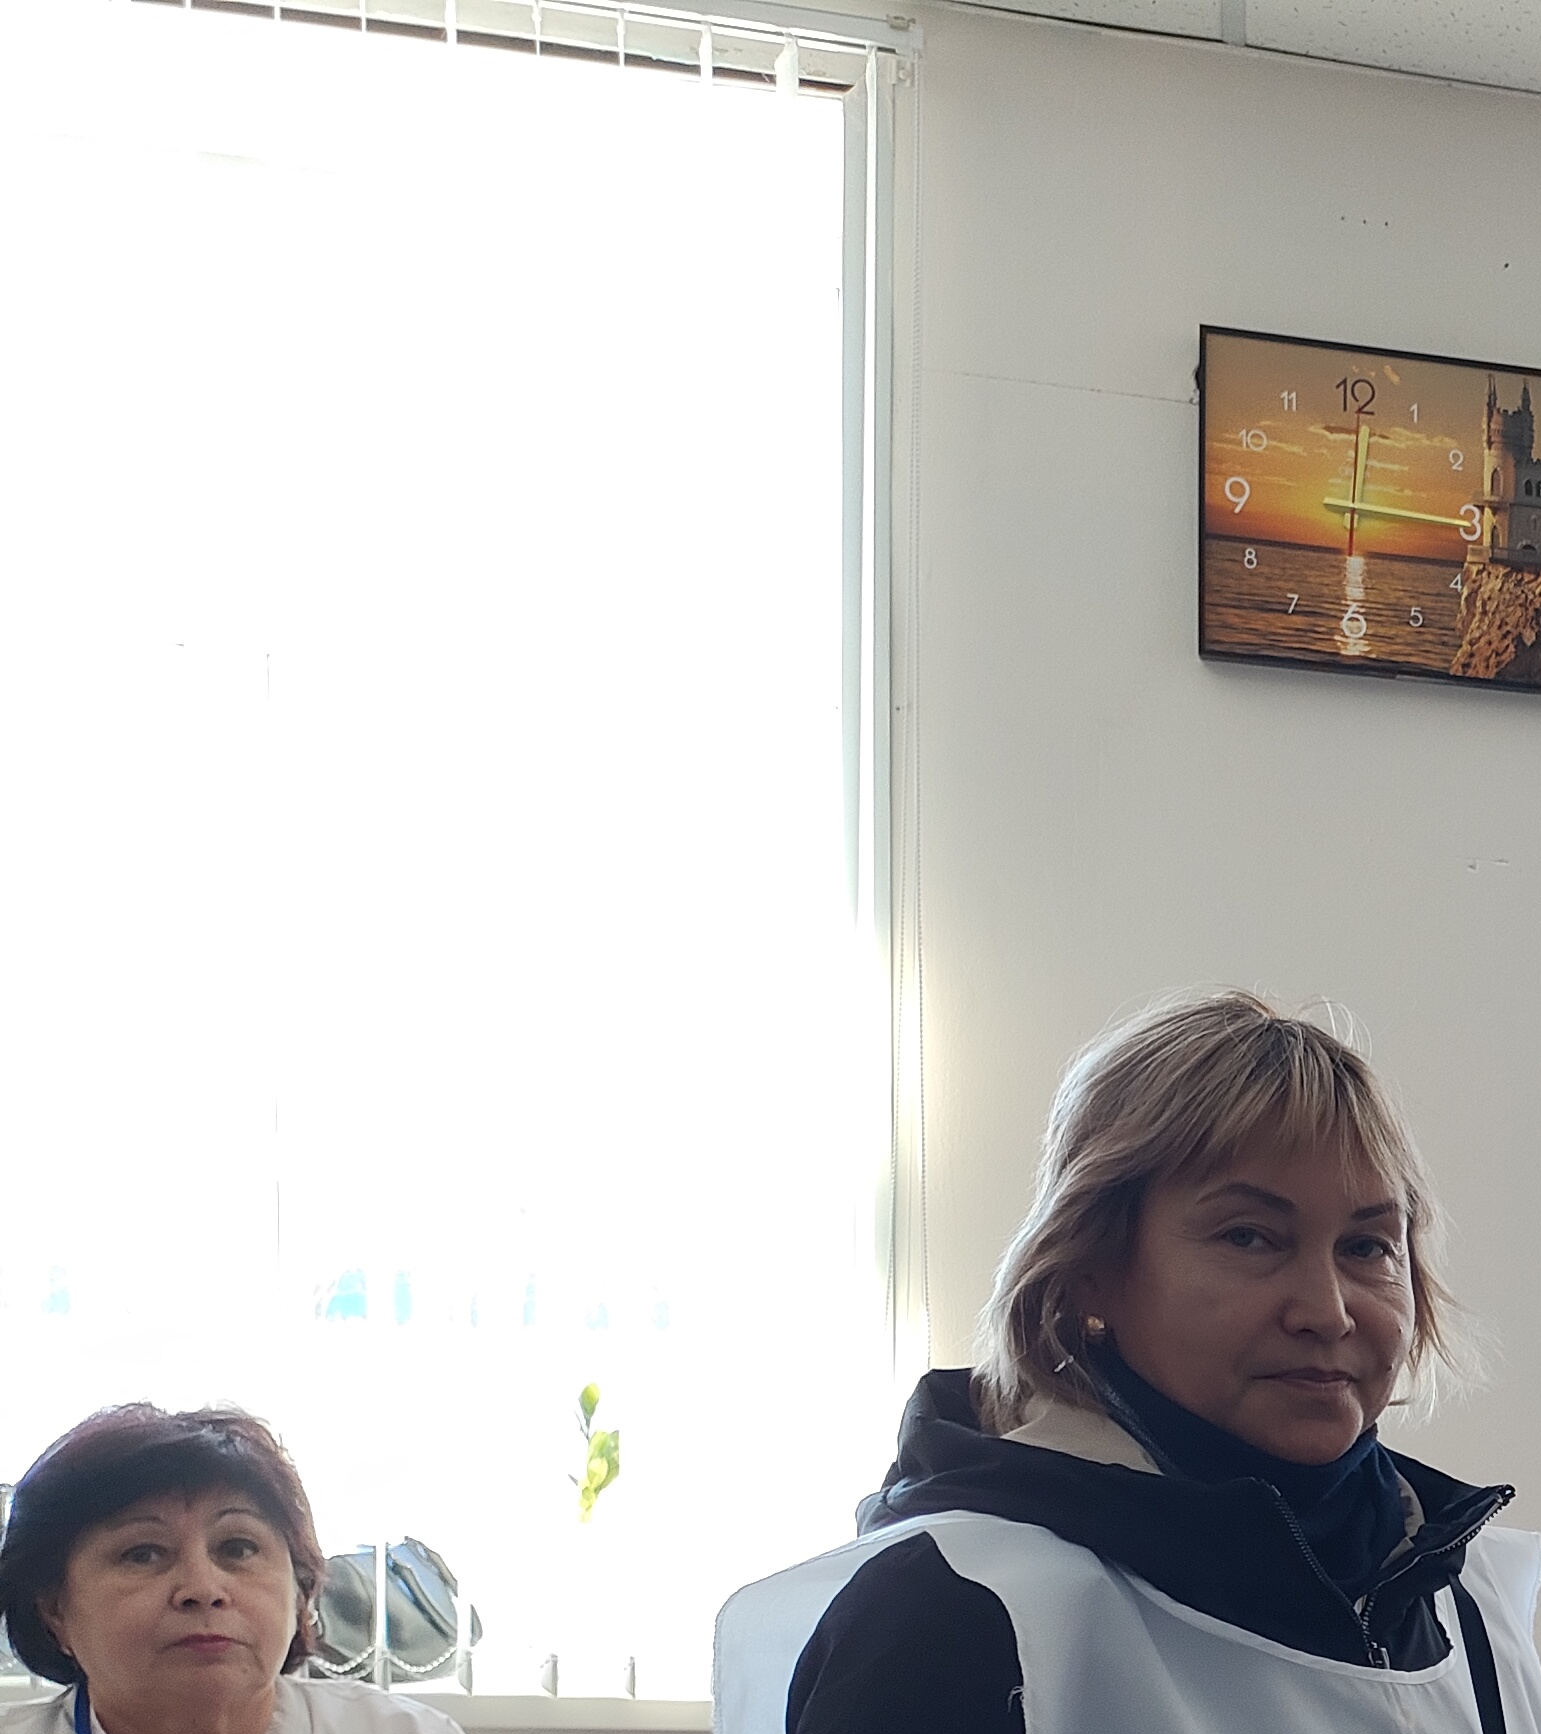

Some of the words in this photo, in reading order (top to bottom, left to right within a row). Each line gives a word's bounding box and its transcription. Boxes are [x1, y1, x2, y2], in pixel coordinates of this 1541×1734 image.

[1280, 391, 1298, 411] 11
[1335, 378, 1376, 416] 12
[1409, 403, 1419, 424] 1
[1239, 429, 1268, 451] 10
[1449, 450, 1464, 471] 2
[1225, 477, 1250, 514] 9
[1459, 503, 1481, 542] 3
[1243, 548, 1258, 569] 8
[1450, 572, 1463, 592] 4
[1286, 594, 1299, 615] 7
[1342, 603, 1367, 638] 6
[1409, 607, 1423, 628] 5
